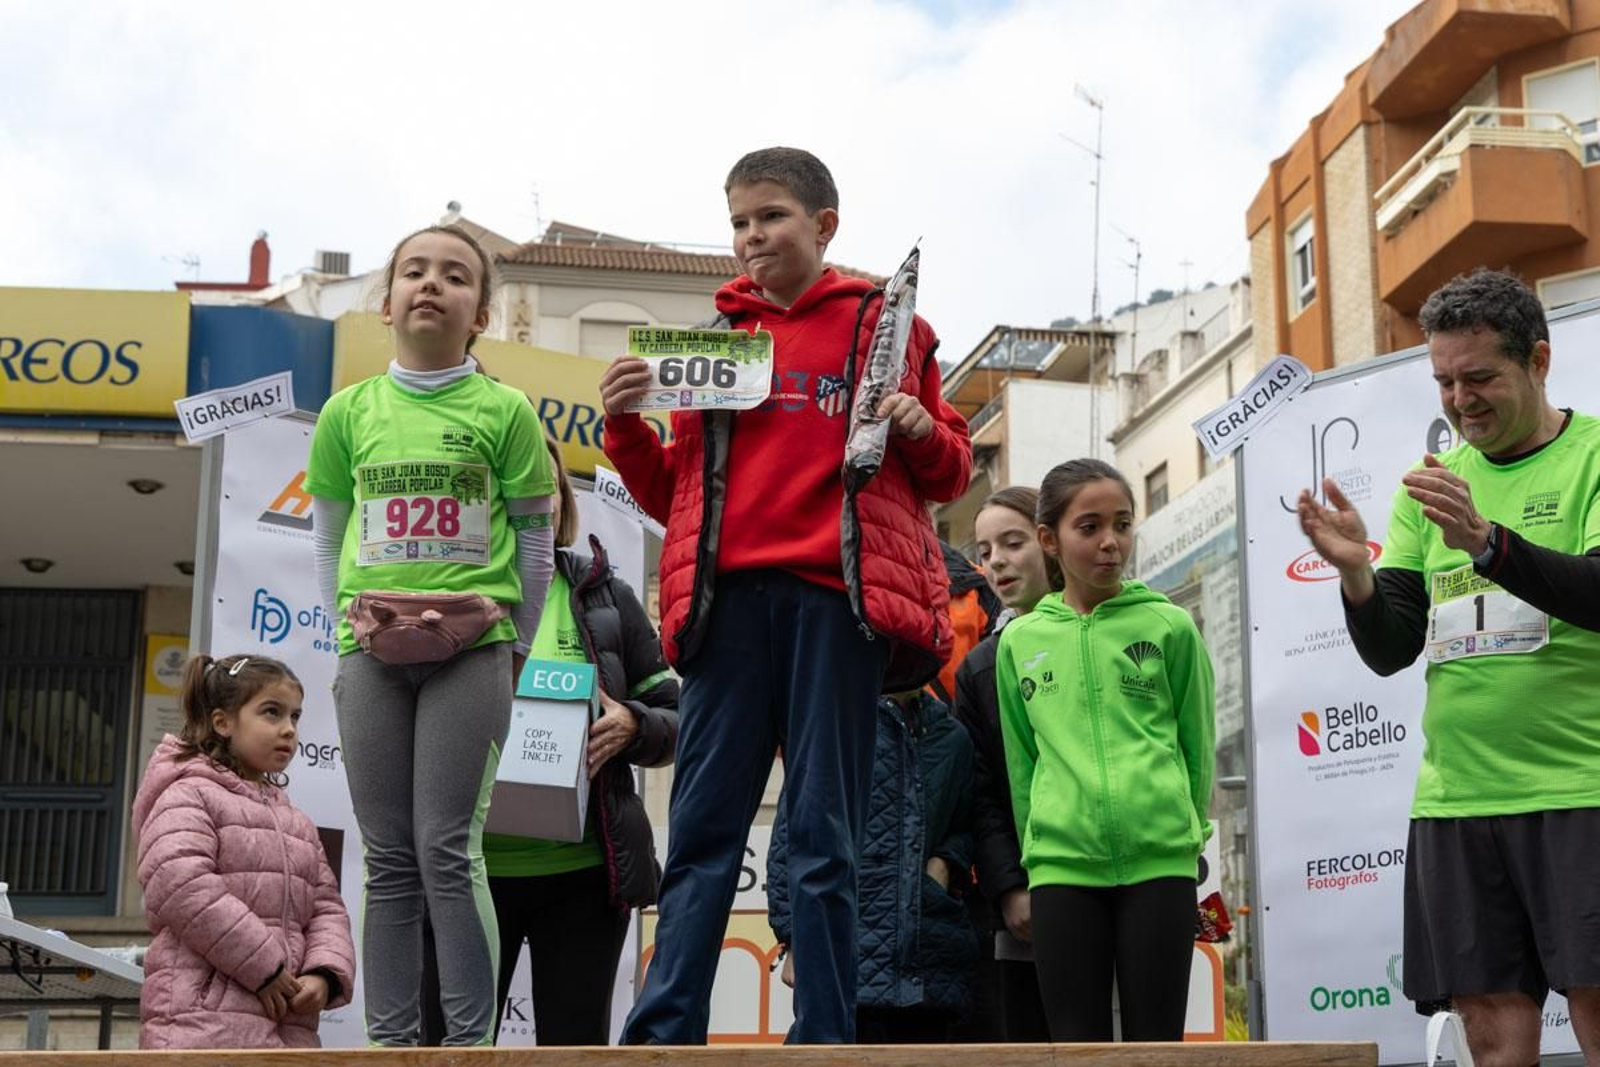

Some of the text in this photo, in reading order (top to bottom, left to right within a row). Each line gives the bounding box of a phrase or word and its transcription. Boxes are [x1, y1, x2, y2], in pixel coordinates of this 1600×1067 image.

[640, 343, 721, 353] IV CARRERA POPULAR
[655, 331, 673, 342] SAN
[676, 332, 700, 342] JUAN
[702, 332, 728, 343] BOSCO
[659, 356, 737, 388] 606
[185, 385, 282, 430] ¡GRACIAS!
[1207, 363, 1297, 446] ¡GRACIAS!
[381, 468, 396, 479] SAN
[398, 465, 422, 478] JUAN
[424, 464, 450, 478] BOSCO
[377, 480, 407, 494] CARRERA
[409, 478, 444, 492] POPULAR
[599, 477, 647, 515] ¡GRAC
[386, 497, 460, 538] 928
[1474, 594, 1485, 632] 1
[1325, 702, 1378, 730] Bello
[523, 739, 558, 752] LASER
[524, 728, 552, 740] COPY
[1327, 721, 1406, 752] Cabello
[521, 750, 562, 764] INKJET
[1306, 849, 1404, 876] FERCOLOR
[1307, 871, 1378, 892] Fotógrafos
[1310, 986, 1390, 1012] Orona
